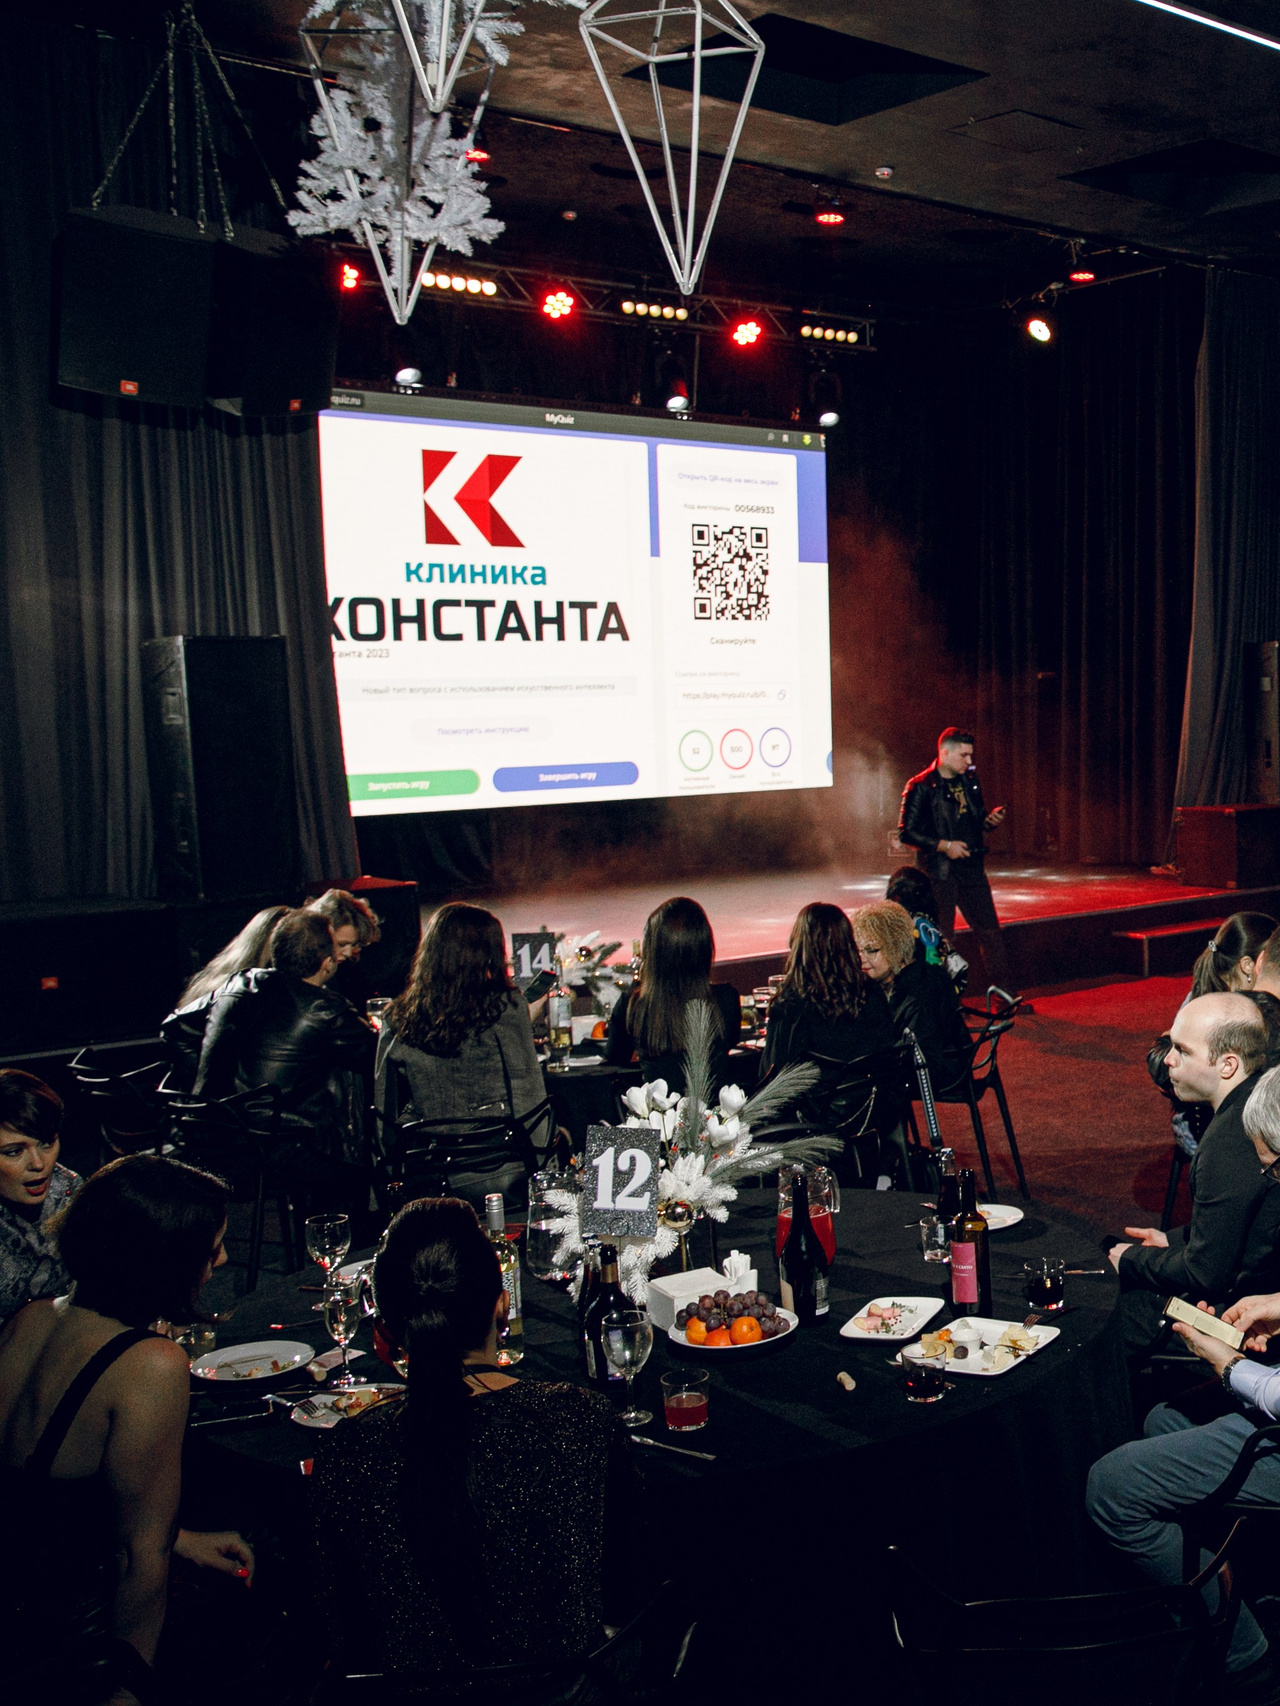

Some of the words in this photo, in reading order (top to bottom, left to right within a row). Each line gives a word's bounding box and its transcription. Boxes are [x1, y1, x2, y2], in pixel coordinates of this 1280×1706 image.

[330, 394, 361, 406] quiz.ru
[545, 413, 575, 425] MyQuiz
[405, 562, 547, 585] клиника
[330, 597, 630, 641] КОНСТАНТА
[710, 637, 756, 646] Сканируйте
[366, 649, 390, 658] 2023
[361, 686, 390, 694] Новый
[409, 686, 442, 696] вопроса
[516, 942, 553, 978] 14
[592, 1146, 652, 1210] 12
